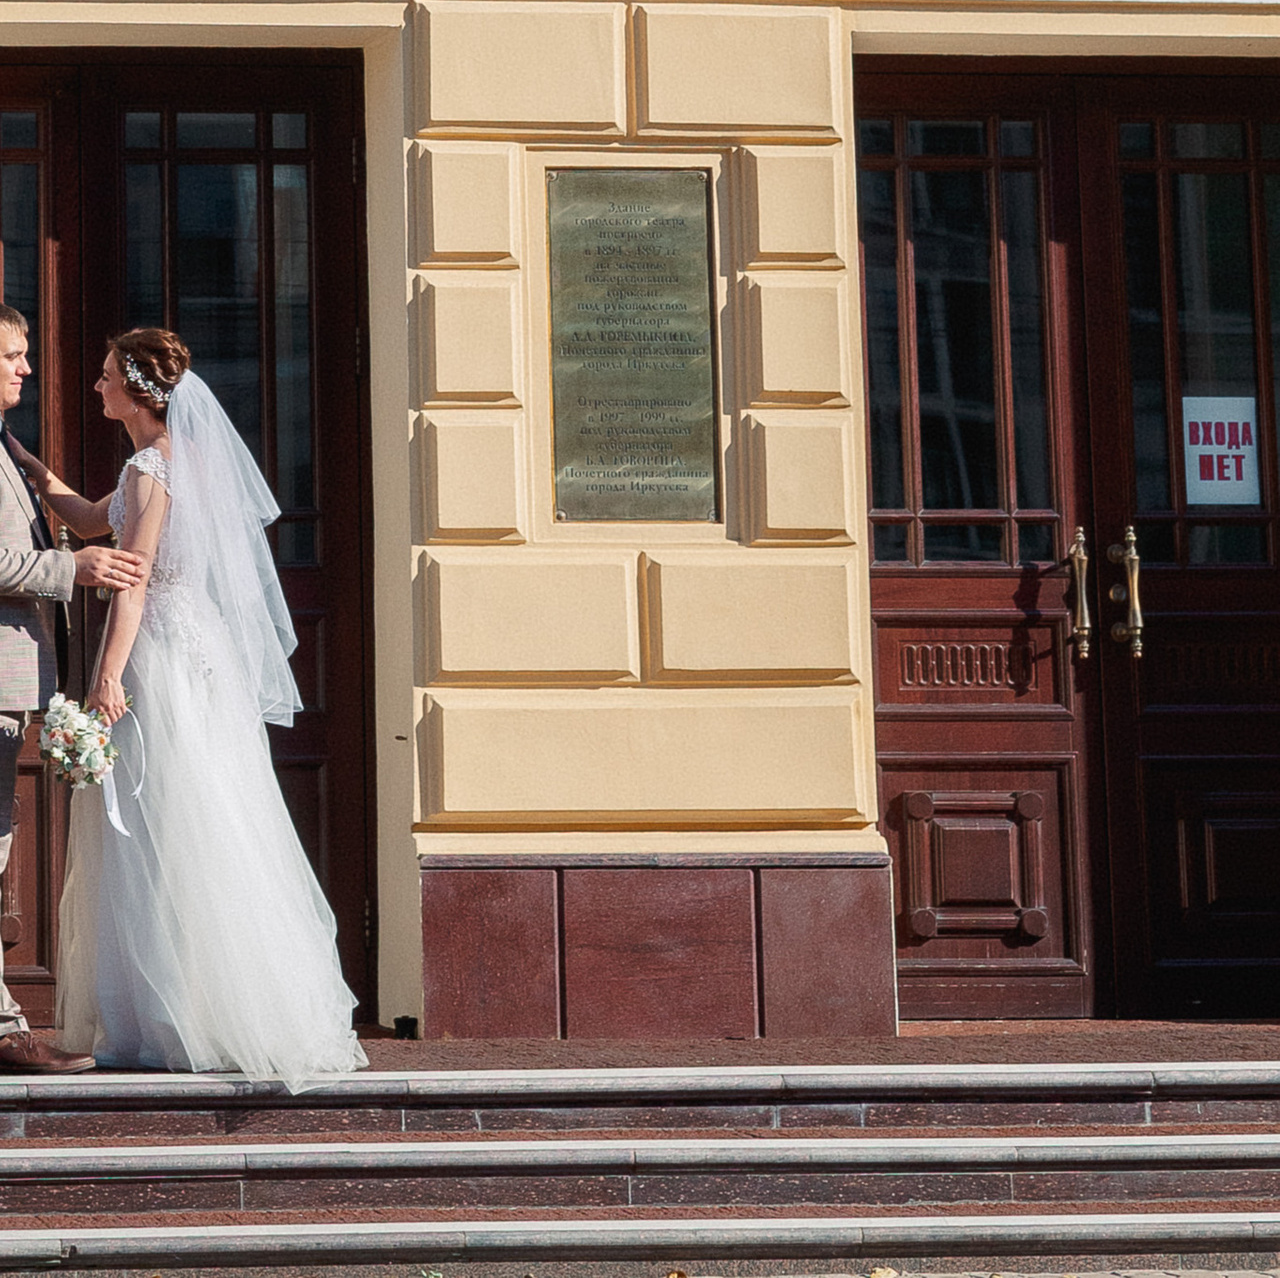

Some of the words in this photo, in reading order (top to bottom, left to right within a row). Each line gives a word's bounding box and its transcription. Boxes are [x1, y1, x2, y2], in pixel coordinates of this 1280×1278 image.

[608, 201, 651, 213] Здание
[575, 218, 642, 229] городского
[646, 218, 685, 229] театра
[577, 303, 600, 312] под
[604, 302, 688, 314] руководством
[595, 315, 670, 327] губернатора
[582, 361, 623, 372] города
[627, 358, 686, 373] Иркутска
[640, 412, 666, 423] 1999
[1188, 421, 1253, 450] ВХОДА
[1199, 454, 1245, 481] НЕТ
[585, 483, 626, 493] города
[630, 481, 689, 494] Иркутска
